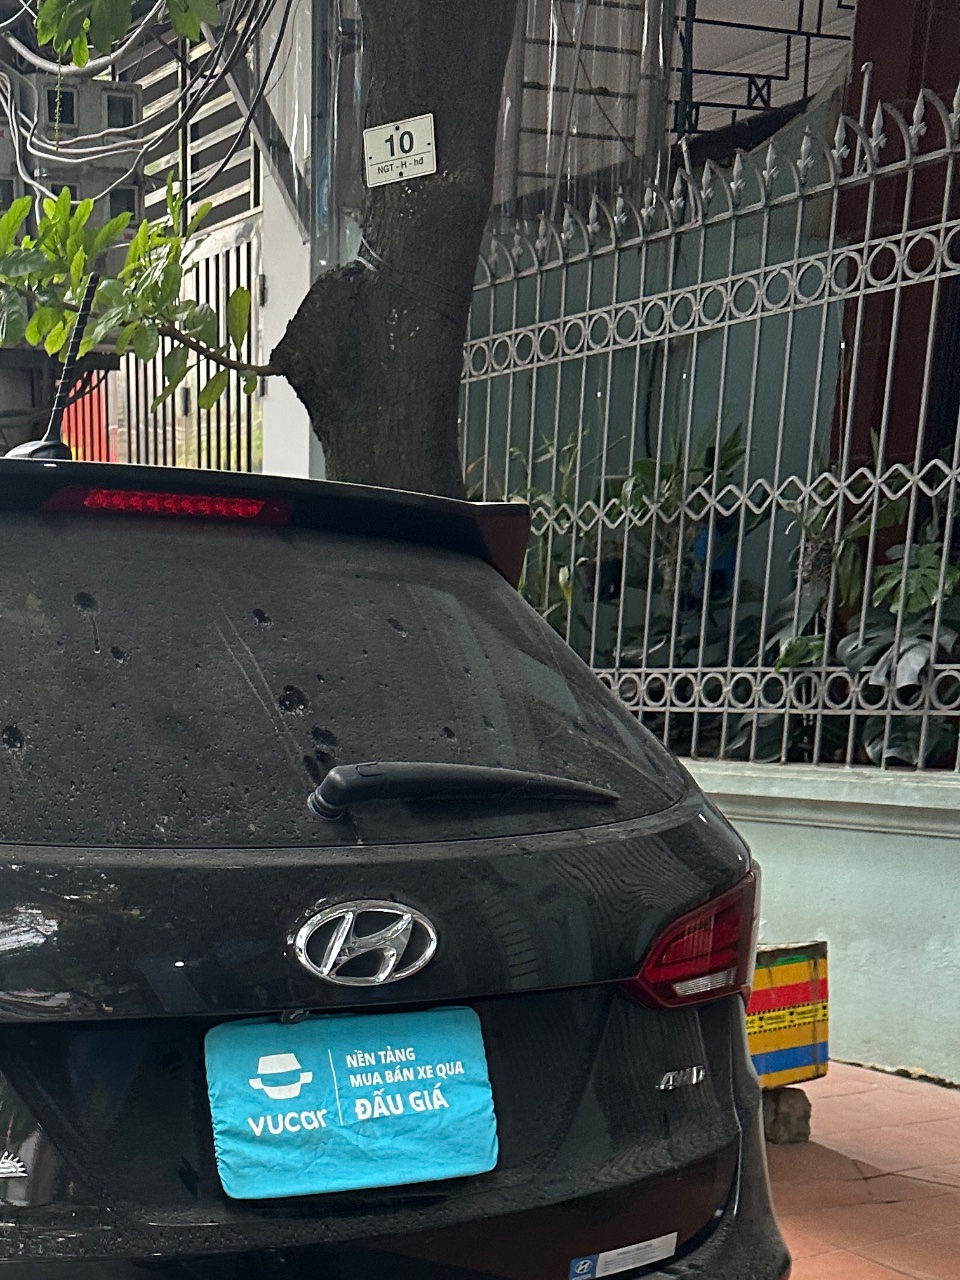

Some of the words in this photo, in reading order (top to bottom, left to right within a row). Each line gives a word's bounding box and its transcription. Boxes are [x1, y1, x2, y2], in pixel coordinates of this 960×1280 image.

[385, 130, 414, 157] 10
[377, 163, 394, 174] NGT
[345, 1050, 377, 1069] NỀN
[377, 1045, 416, 1065] TẢNG
[349, 1072, 383, 1088] MUA
[385, 1064, 415, 1084] BÁN
[417, 1065, 435, 1080] XE
[436, 1060, 465, 1079] QUA
[354, 1088, 405, 1121] ĐẤU
[408, 1082, 450, 1111] GIÁ
